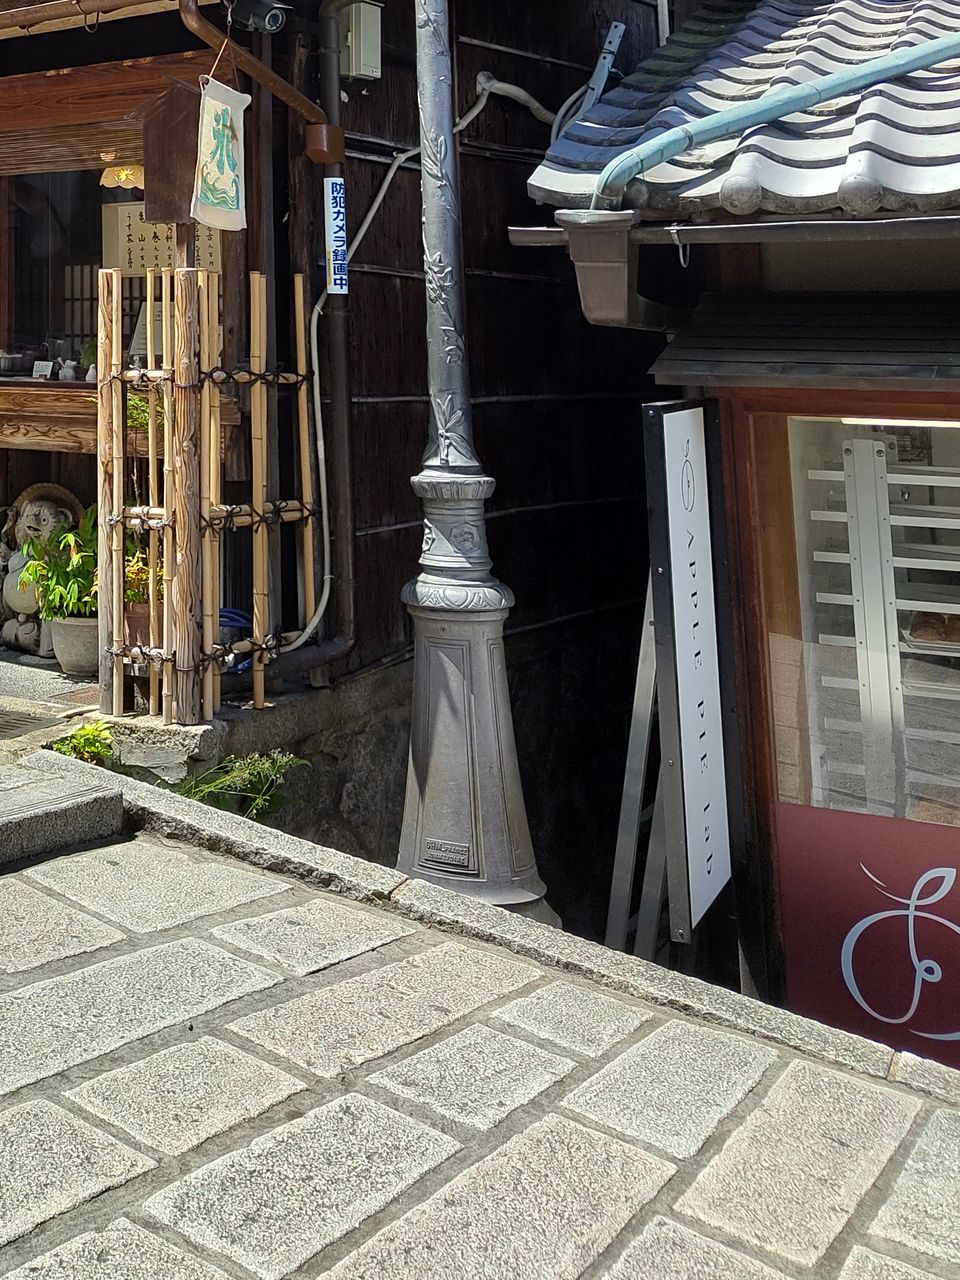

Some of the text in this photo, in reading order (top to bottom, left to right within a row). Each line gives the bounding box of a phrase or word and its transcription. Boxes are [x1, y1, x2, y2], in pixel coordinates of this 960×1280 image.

[208, 106, 237, 175] 氷
[330, 182, 348, 290] 防犯カメラ録画中
[686, 529, 703, 671] APPLE
[697, 700, 708, 774] PIE
